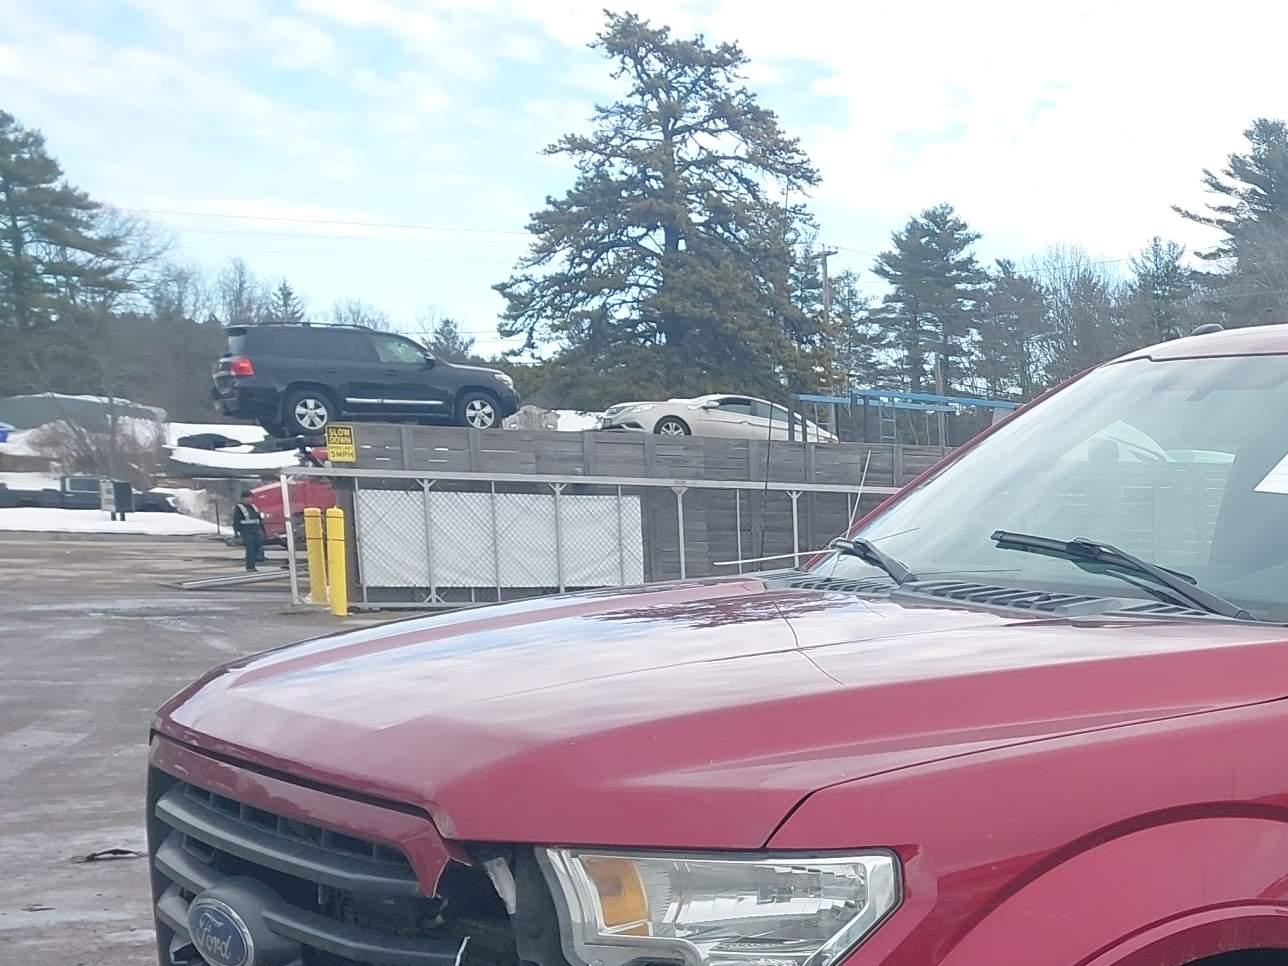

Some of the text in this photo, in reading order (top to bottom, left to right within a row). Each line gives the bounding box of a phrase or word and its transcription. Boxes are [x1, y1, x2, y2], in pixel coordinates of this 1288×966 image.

[329, 428, 350, 436] SLOW
[330, 436, 352, 444] DOWN
[196, 912, 232, 960] Ford
